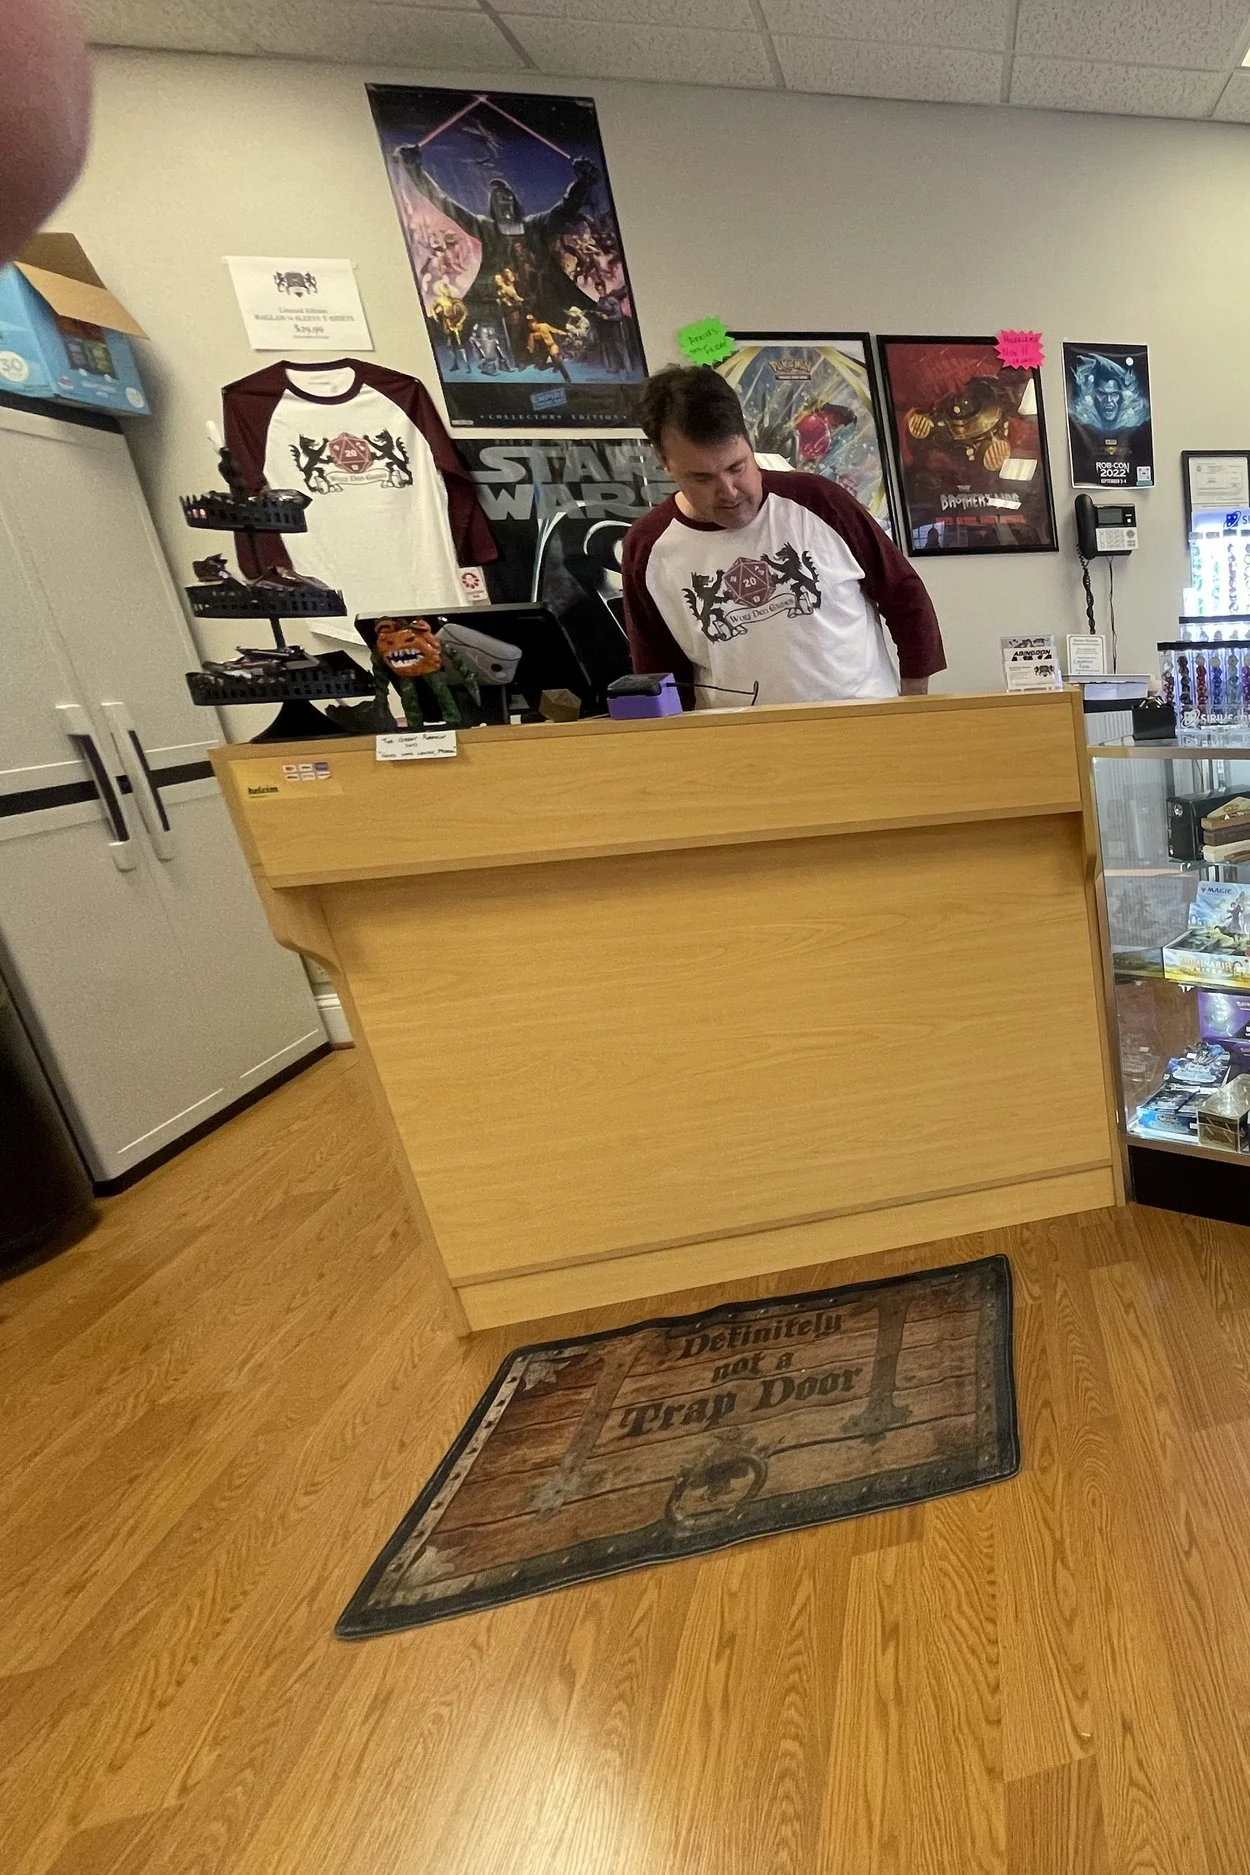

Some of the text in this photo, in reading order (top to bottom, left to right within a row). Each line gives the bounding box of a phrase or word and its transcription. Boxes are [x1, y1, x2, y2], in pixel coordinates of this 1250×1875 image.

[470, 446, 672, 483] STAR
[1096, 462, 1130, 474] ROB-CON
[1100, 469, 1127, 478] 2022
[742, 577, 757, 588] 20
[1013, 649, 1051, 657] ABINGDON
[678, 1312, 843, 1359] Definitely
[711, 1350, 794, 1383] not a
[618, 1366, 863, 1438] Trap Door
